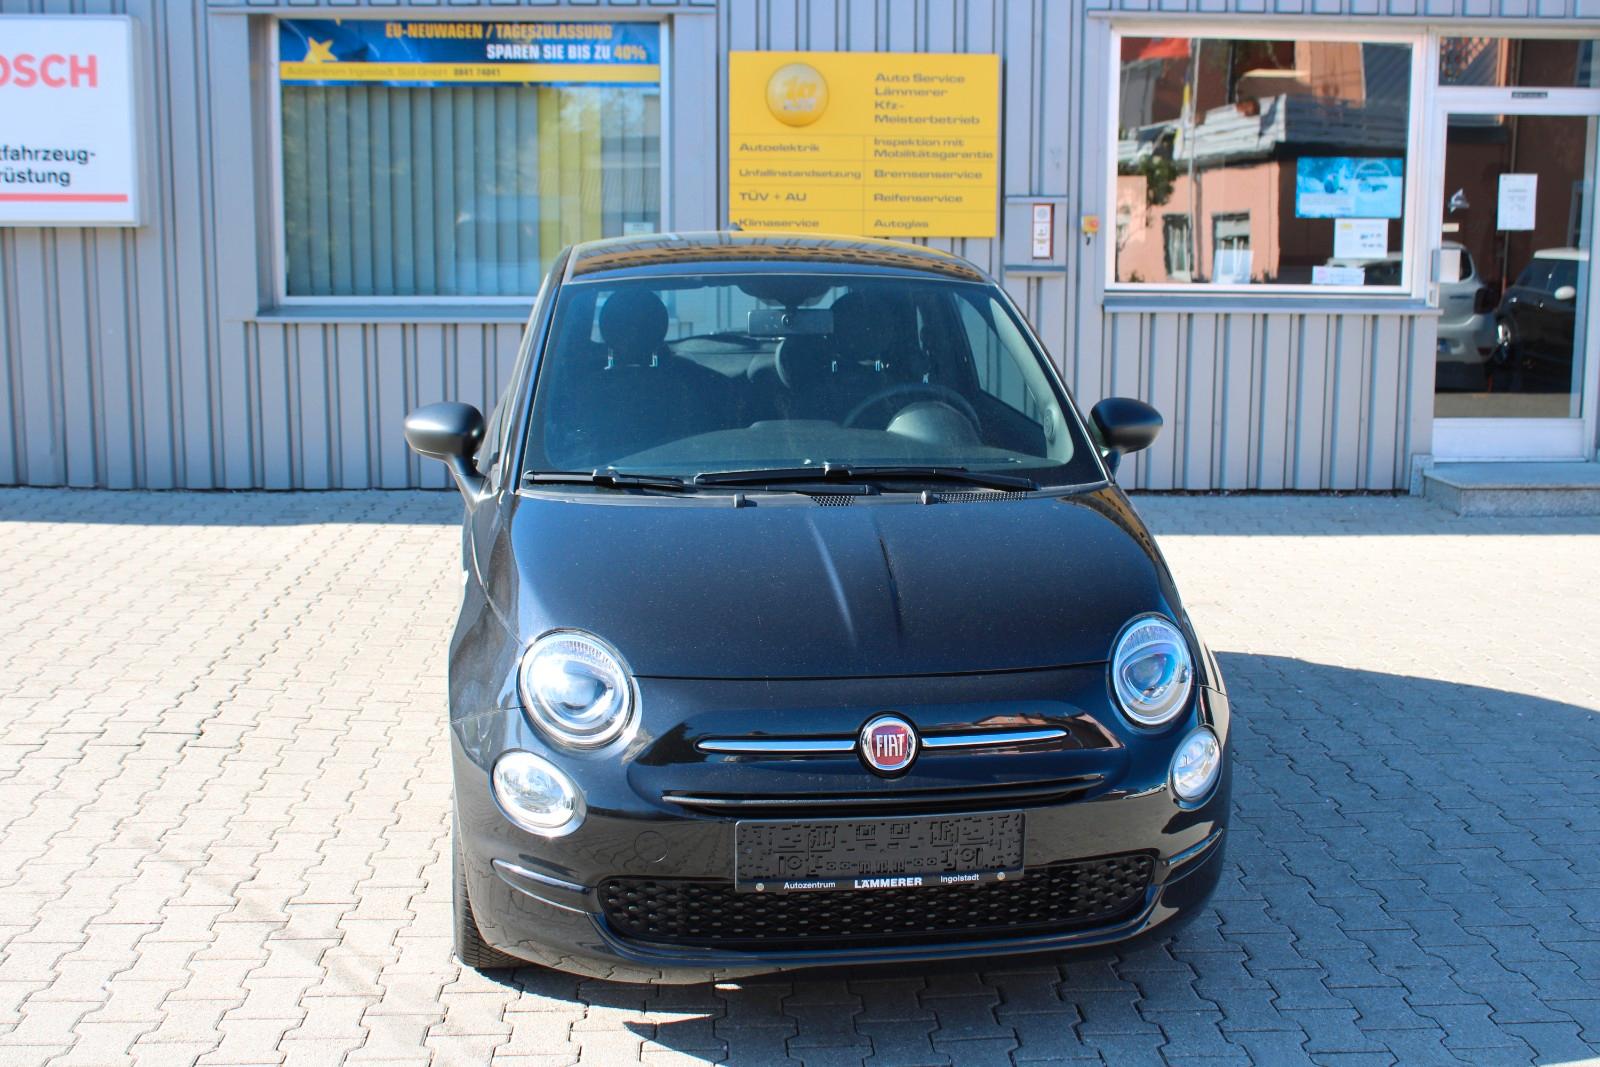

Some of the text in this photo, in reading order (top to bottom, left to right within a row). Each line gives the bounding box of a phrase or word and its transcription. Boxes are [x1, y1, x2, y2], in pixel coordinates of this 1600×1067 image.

[385, 23, 613, 40] EU-NEUWAGEN / TAGESZULASSUNG
[486, 43, 647, 61] SPAREN SIE BIS ZU 40%
[875, 73, 965, 84] Auto Service
[874, 86, 948, 97] Lämmerer
[874, 114, 981, 125] Meisterbetrieb
[739, 143, 820, 153] Autoelektrik
[874, 137, 965, 148] Inspektion mit
[873, 149, 994, 161] Mobilitätsgarantie
[738, 169, 862, 180] Unfallinstandsetzung
[874, 169, 983, 180] Bremsenservice
[739, 189, 769, 202] TÜV
[785, 192, 808, 202] AU
[873, 192, 964, 203] Reifenservice
[738, 218, 820, 228] Klimaservice
[873, 219, 929, 230] Autoglas
[875, 733, 905, 758] FIAT
[783, 872, 980, 890] Autozentrum LÄMMERER Ingolstadt
